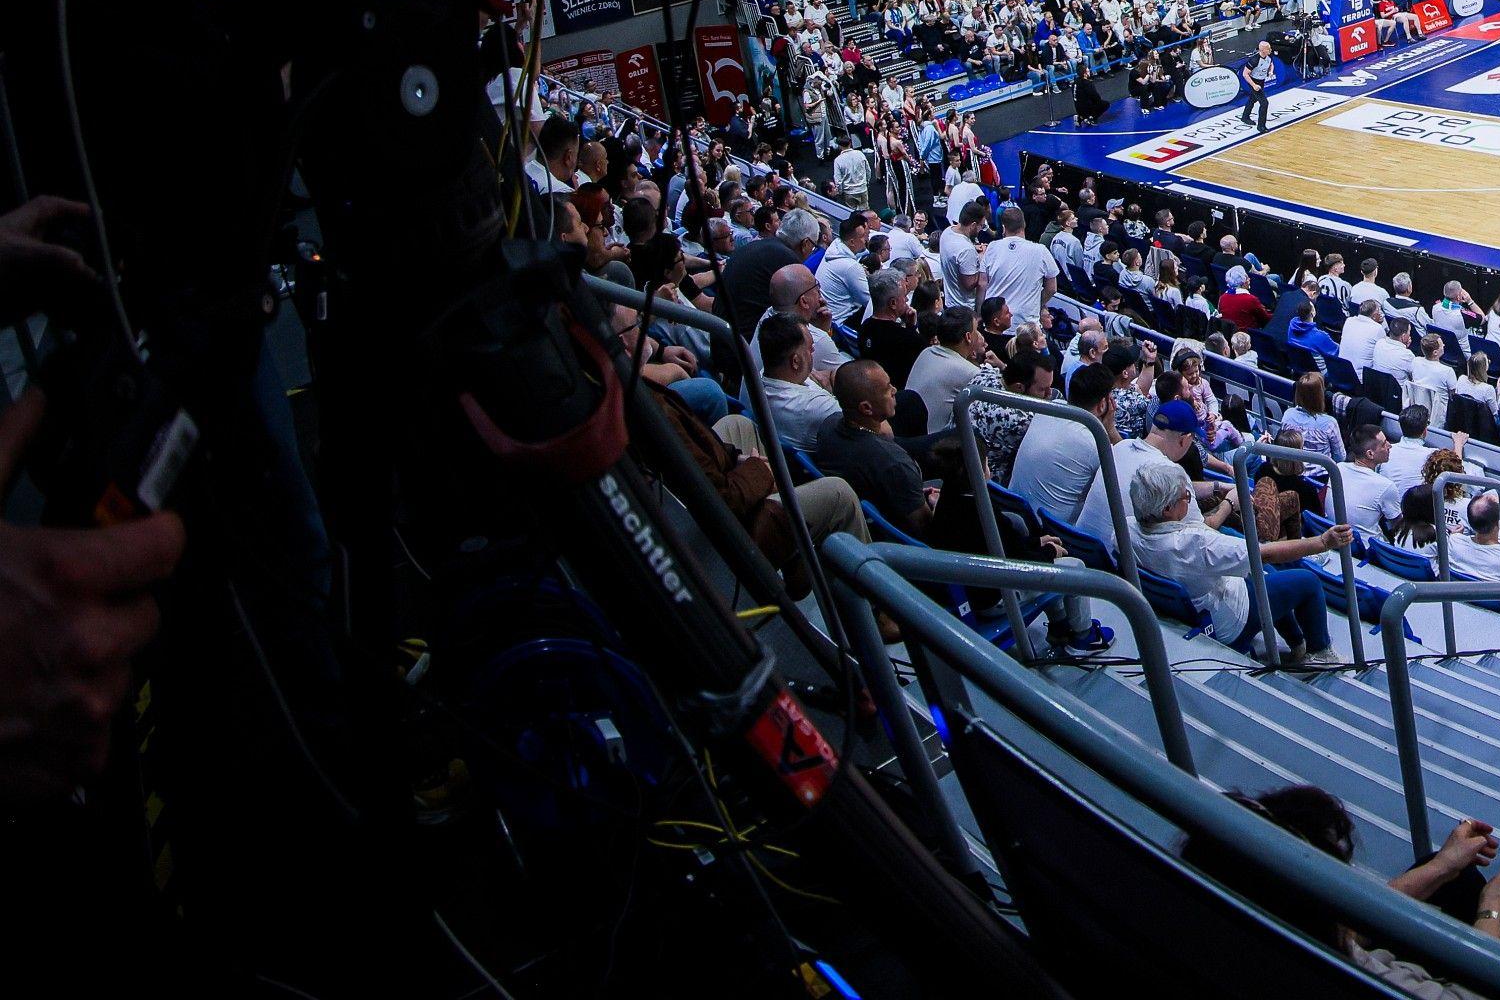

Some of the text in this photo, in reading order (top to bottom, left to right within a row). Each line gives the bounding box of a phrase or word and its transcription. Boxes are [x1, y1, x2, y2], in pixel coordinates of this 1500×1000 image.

[566, 2, 621, 20] WIENIEC ZDRÓJ
[1342, 8, 1372, 24] TERBUD
[1350, 43, 1369, 53] ORLEN
[628, 67, 650, 79] ORLEN
[1384, 111, 1472, 129] pre
[1363, 121, 1476, 146] zero
[598, 473, 695, 605] sachtler
